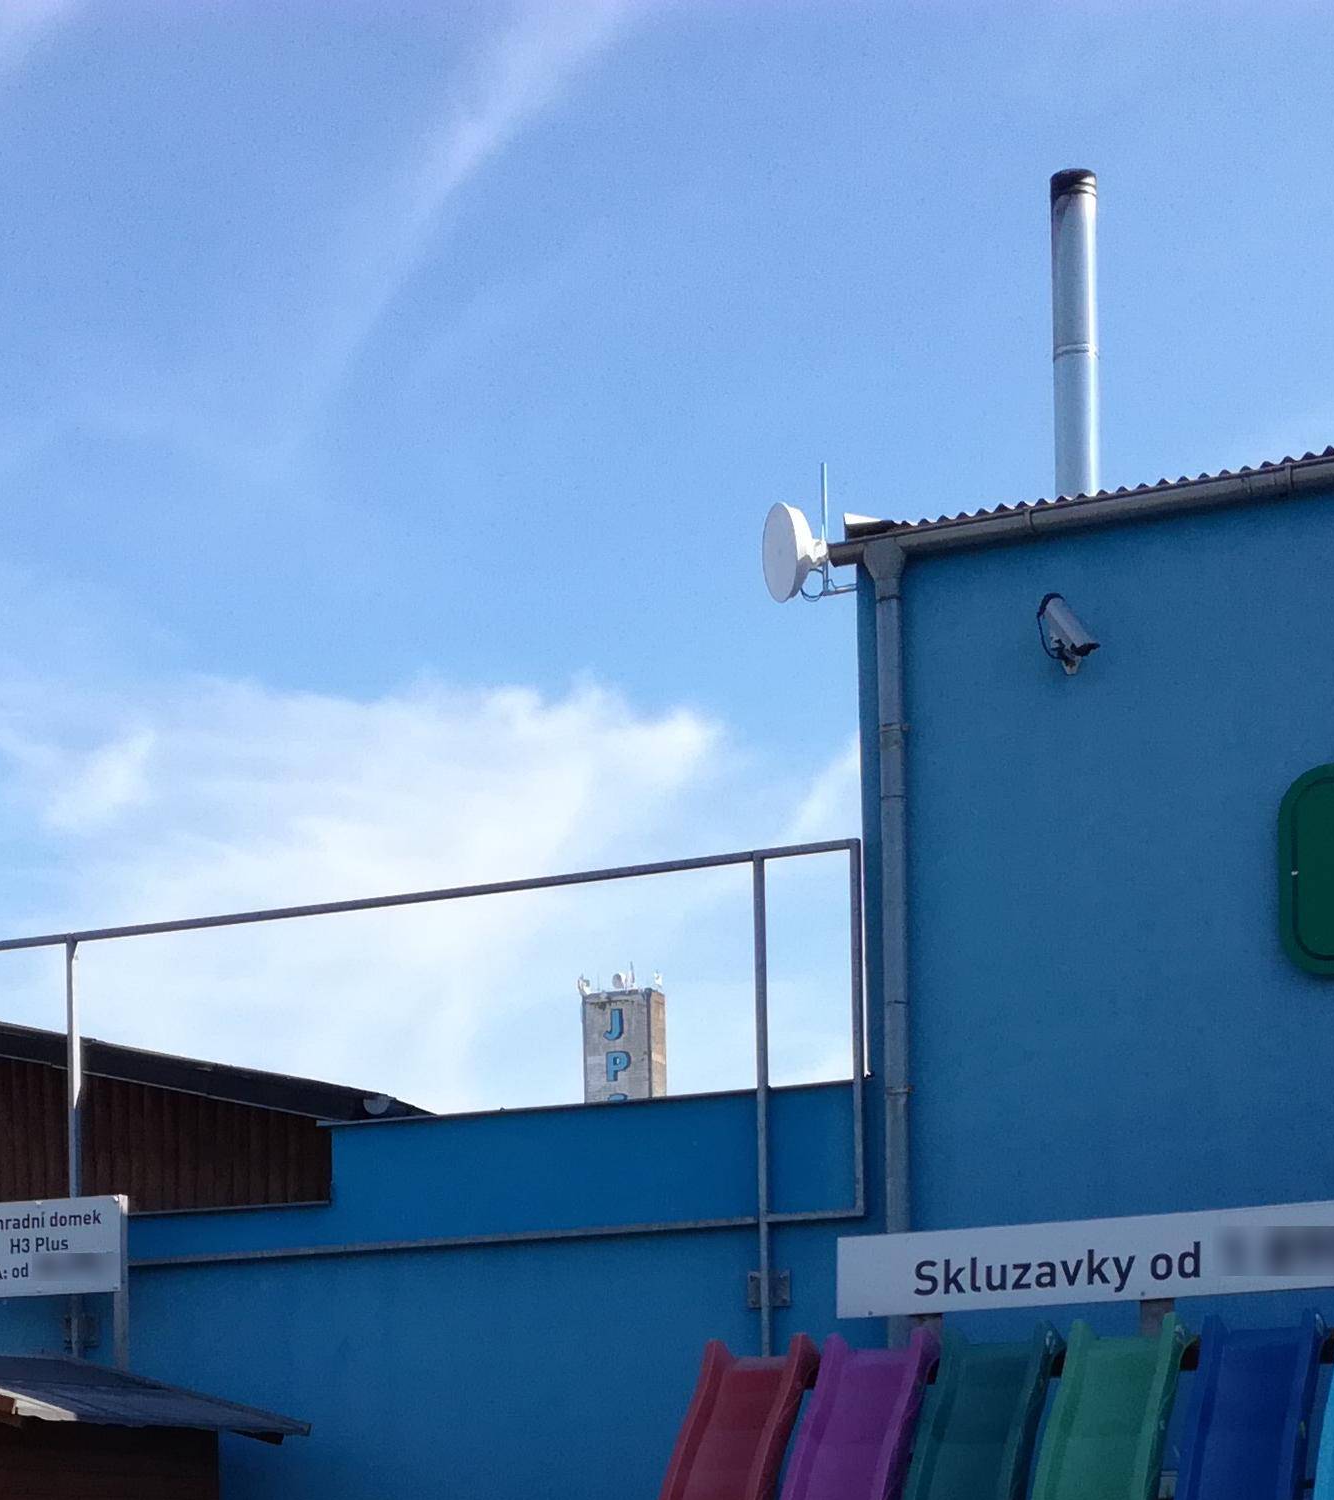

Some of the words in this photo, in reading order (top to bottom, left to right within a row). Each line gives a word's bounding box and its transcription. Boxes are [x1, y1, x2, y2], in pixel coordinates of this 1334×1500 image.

[50, 1209, 102, 1228] domek
[10, 1238, 30, 1254] H3
[35, 1237, 69, 1253] Plus
[12, 1263, 29, 1279] od
[913, 1248, 1136, 1297] Skluzavky
[1150, 1240, 1202, 1281] od
